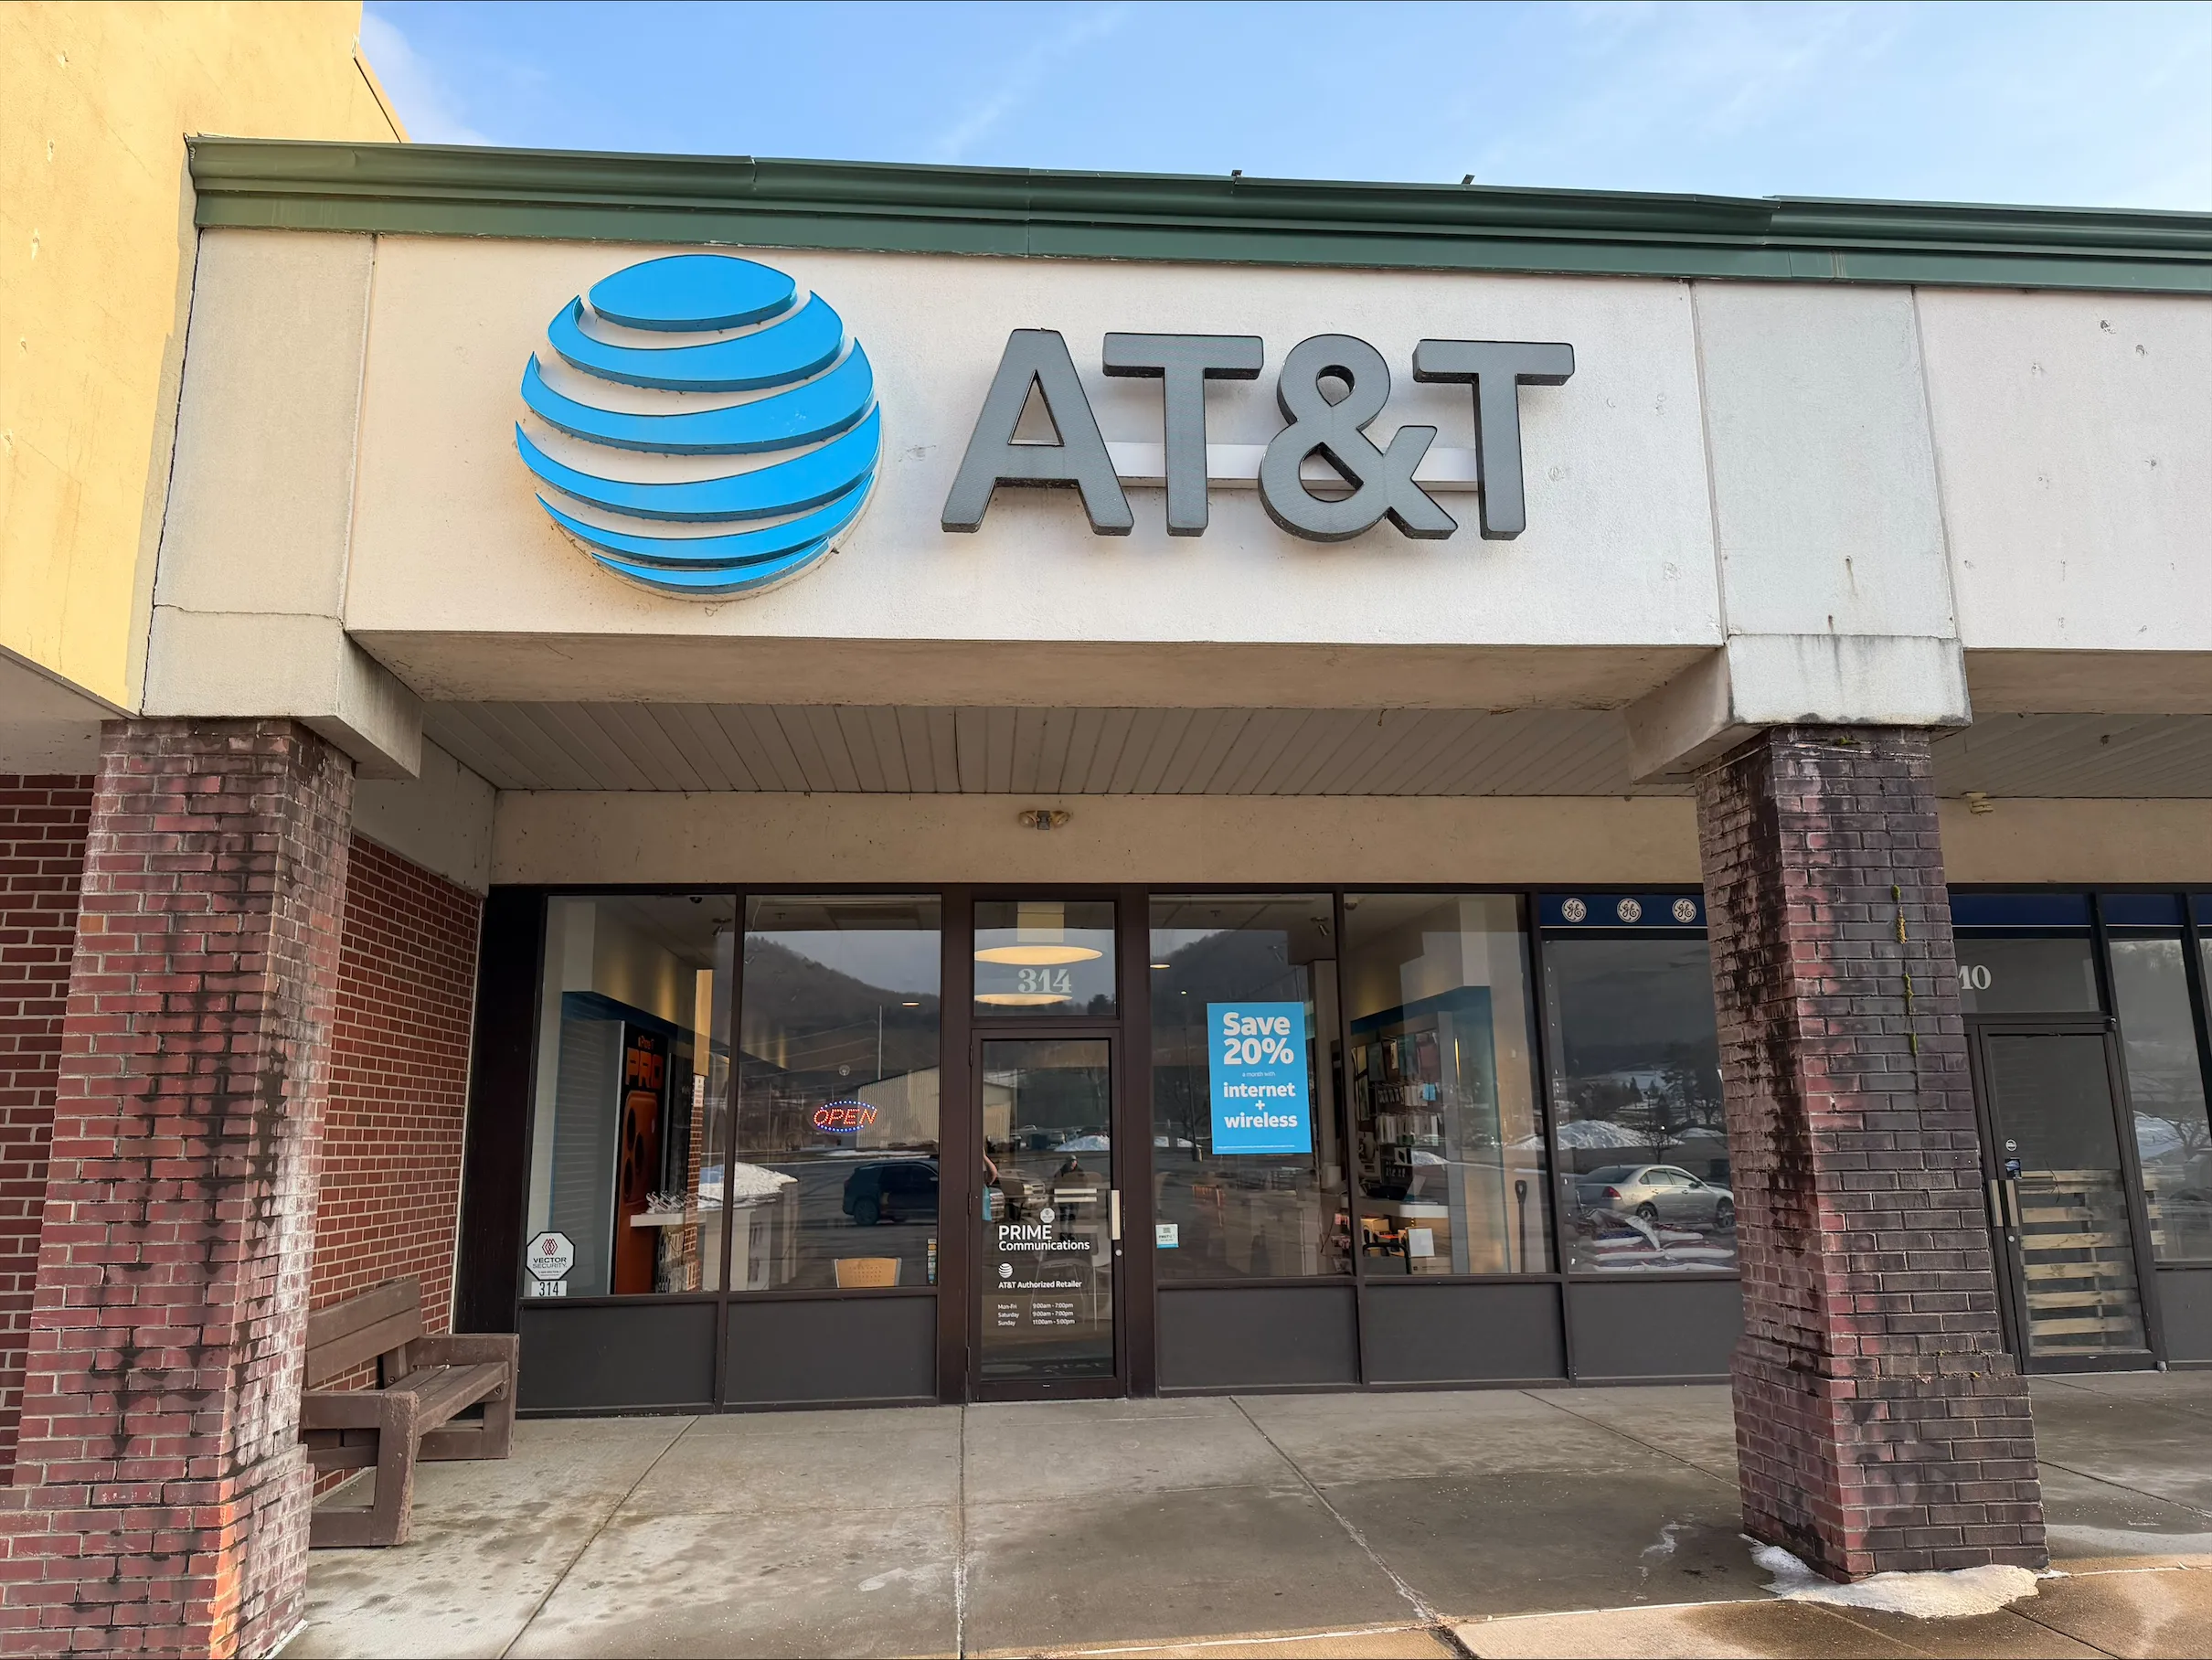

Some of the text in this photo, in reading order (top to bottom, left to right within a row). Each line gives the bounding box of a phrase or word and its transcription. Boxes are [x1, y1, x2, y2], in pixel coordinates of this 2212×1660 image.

[941, 328, 1575, 541] AT&T
[1017, 968, 1072, 994] 314
[1958, 964, 1992, 990] 10
[1223, 1012, 1291, 1036] Save
[1223, 1038, 1294, 1065] 20%
[625, 1047, 664, 1090] PRO
[1223, 1081, 1296, 1097] internet
[1255, 1100, 1265, 1110] +
[813, 1108, 878, 1125] OPEN
[1224, 1112, 1298, 1128] wireless
[998, 1224, 1053, 1240] PRIME
[998, 1240, 1090, 1251] Communications
[538, 1282, 559, 1296] 314
[1017, 1281, 1056, 1289] Authorized
[1056, 1280, 1083, 1288] Retailer
[1055, 1302, 1074, 1310] 7:00pm
